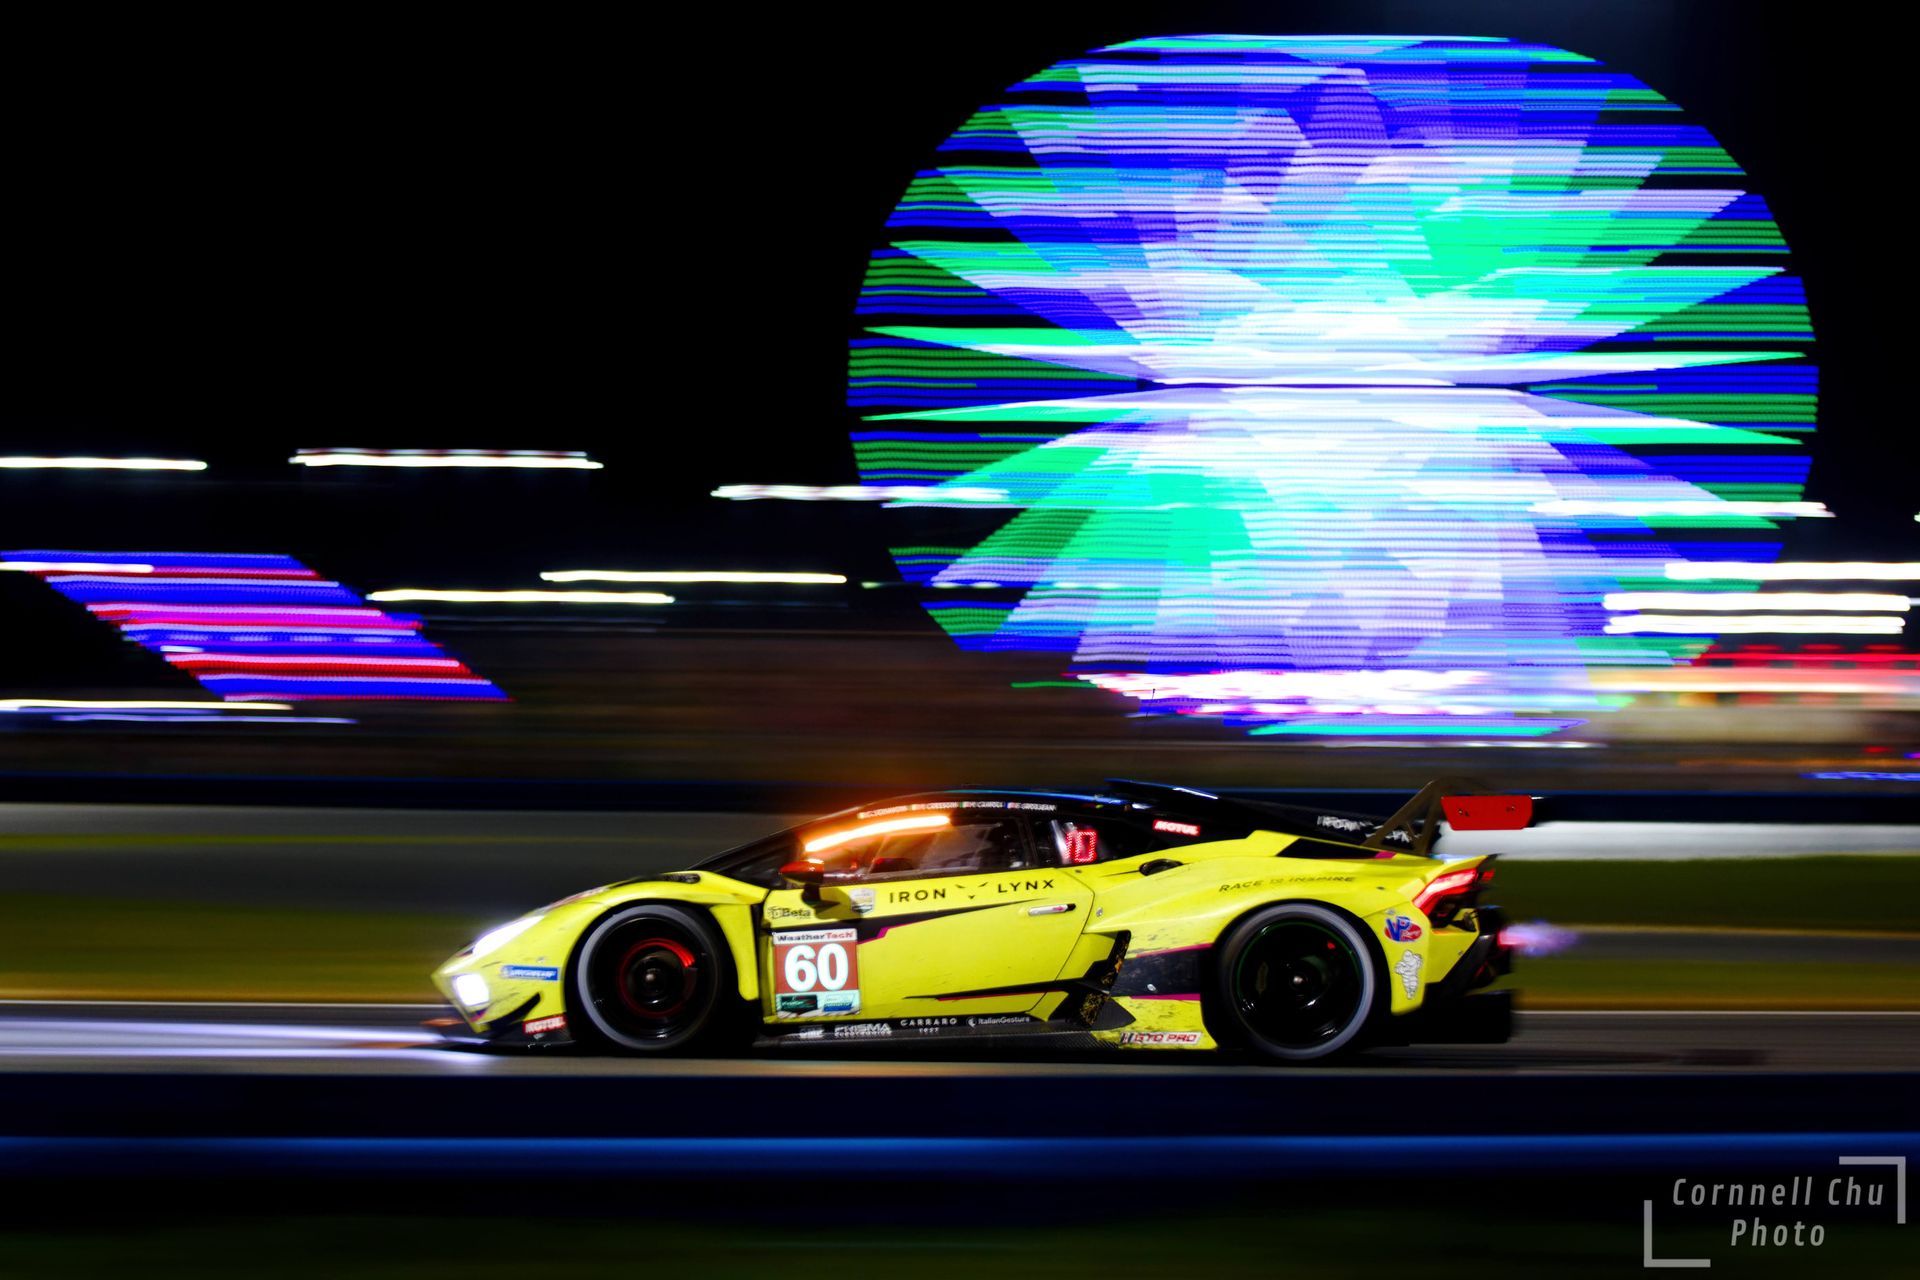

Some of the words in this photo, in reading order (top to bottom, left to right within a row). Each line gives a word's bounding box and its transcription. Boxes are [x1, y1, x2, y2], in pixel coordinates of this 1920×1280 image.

[1154, 820, 1199, 836] MOTUL
[889, 888, 947, 903] IRON
[997, 878, 1055, 894] LYNX
[1219, 880, 1263, 892] RACE
[782, 907, 811, 918] Beta
[1386, 916, 1411, 942] VP
[777, 931, 854, 942] WeatherTech
[784, 943, 849, 992] 60
[900, 1017, 957, 1027] CARRARO
[1167, 1033, 1197, 1042] PRO
